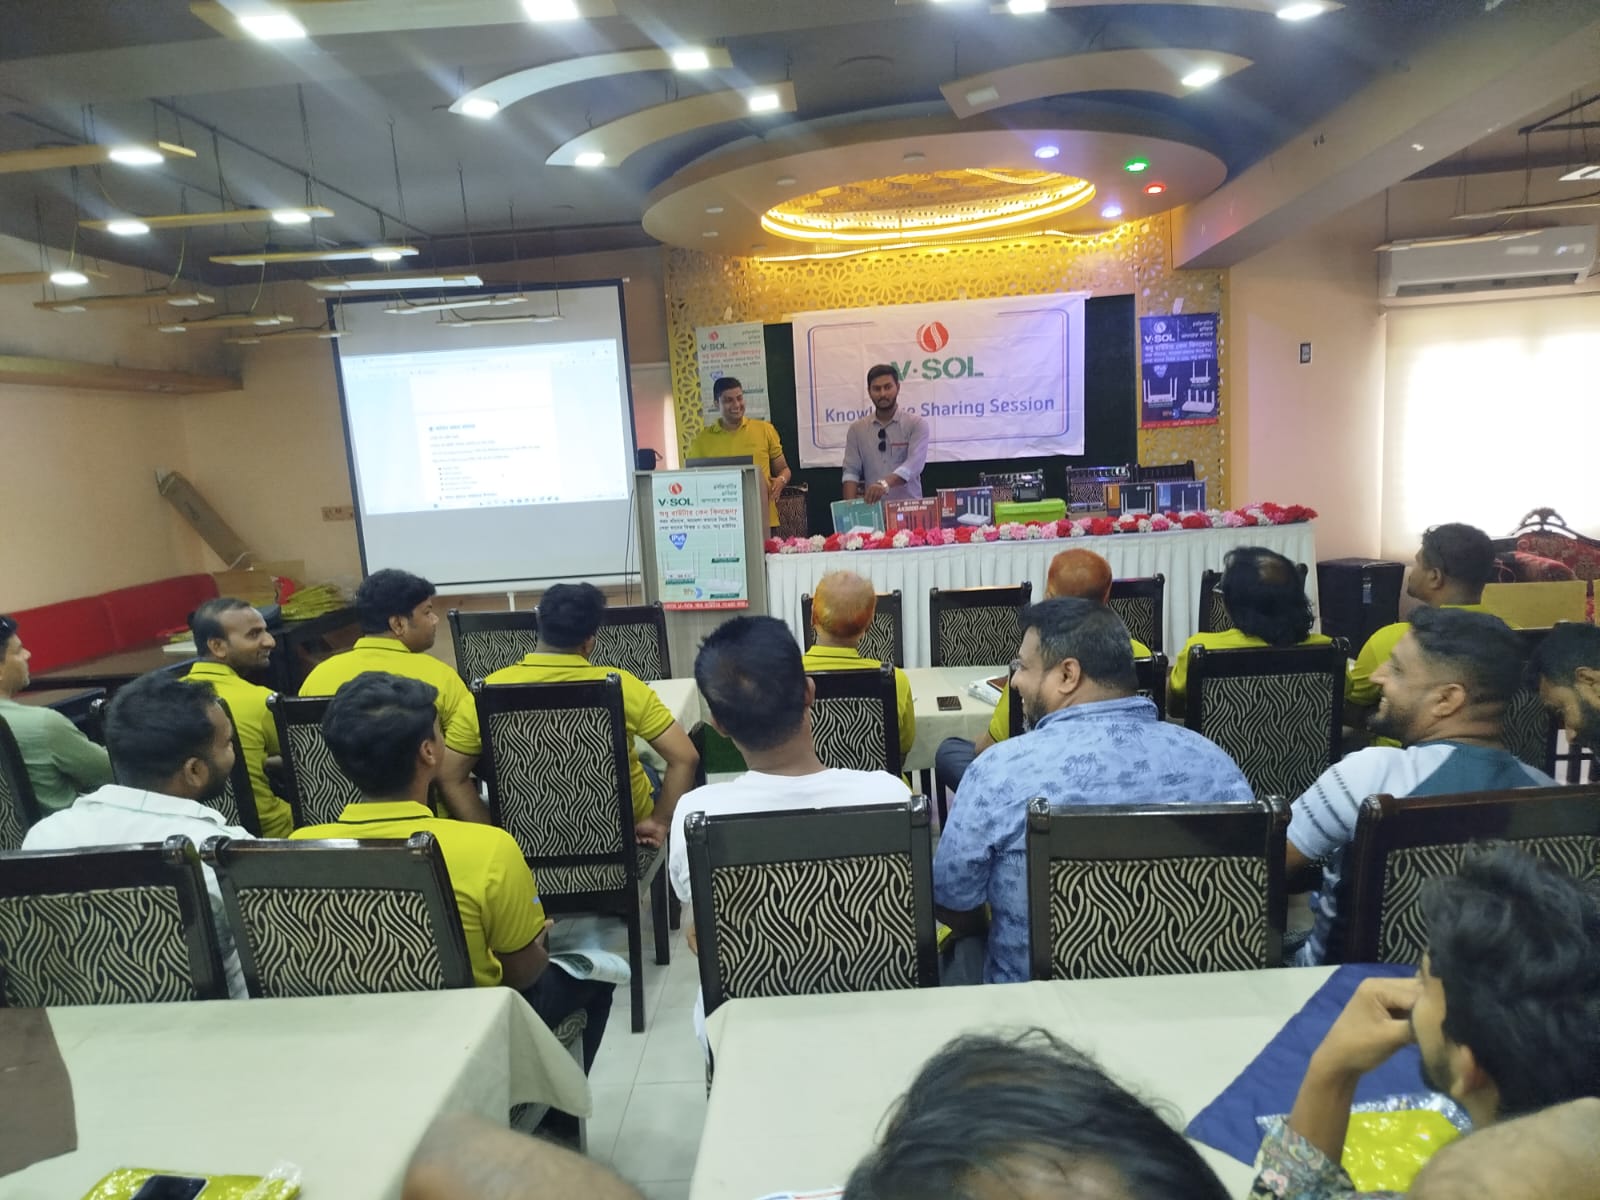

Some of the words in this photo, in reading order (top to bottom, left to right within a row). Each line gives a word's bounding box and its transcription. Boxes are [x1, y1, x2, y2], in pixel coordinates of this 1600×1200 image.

[825, 406, 916, 422] Knowle
[921, 401, 985, 417] Sharing
[990, 397, 1055, 413] Session
